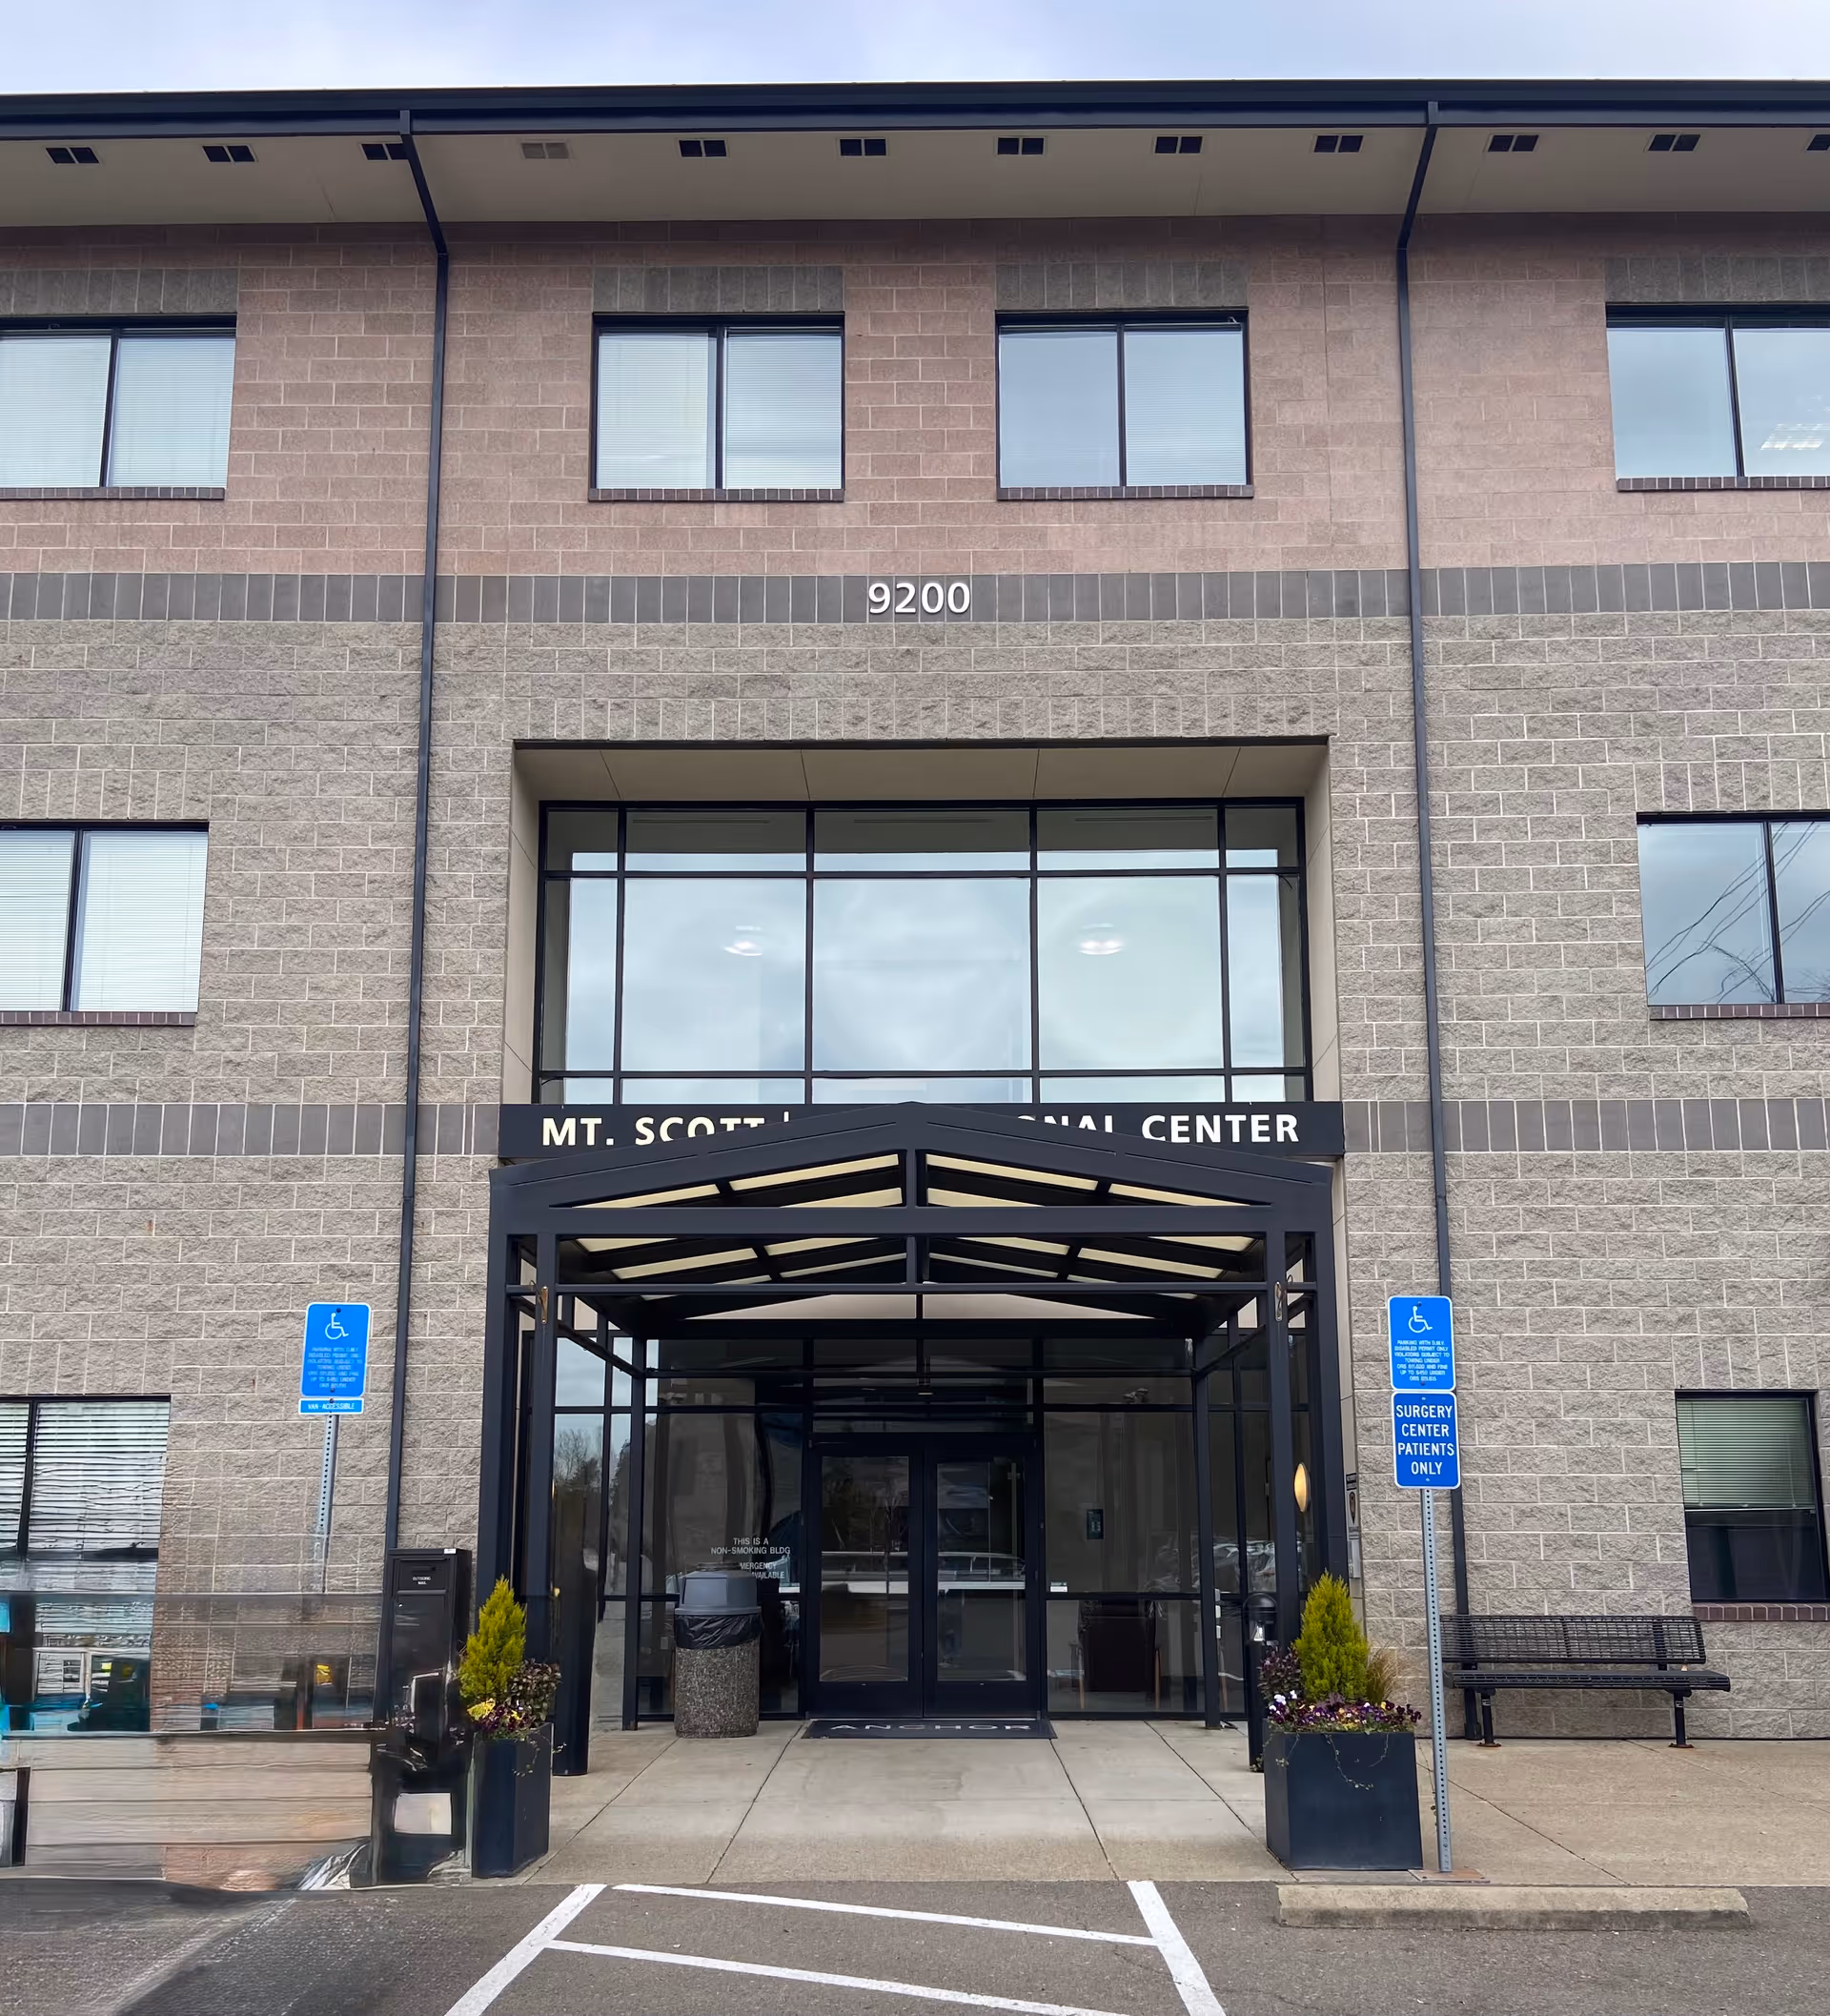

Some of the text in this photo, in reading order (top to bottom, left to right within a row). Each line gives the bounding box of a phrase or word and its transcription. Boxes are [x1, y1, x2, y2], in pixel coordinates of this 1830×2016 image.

[868, 581, 970, 615] 9200
[542, 1116, 615, 1147] MT.
[1141, 1113, 1299, 1143] CENTER
[1395, 1404, 1453, 1418] SURGERY
[1401, 1423, 1450, 1437] CENTER
[1397, 1442, 1454, 1456] PATIENTS
[1411, 1461, 1443, 1475] ONLY
[710, 1546, 791, 1555] NON-SMOKING BLDG
[740, 1561, 777, 1570] MERGENCY
